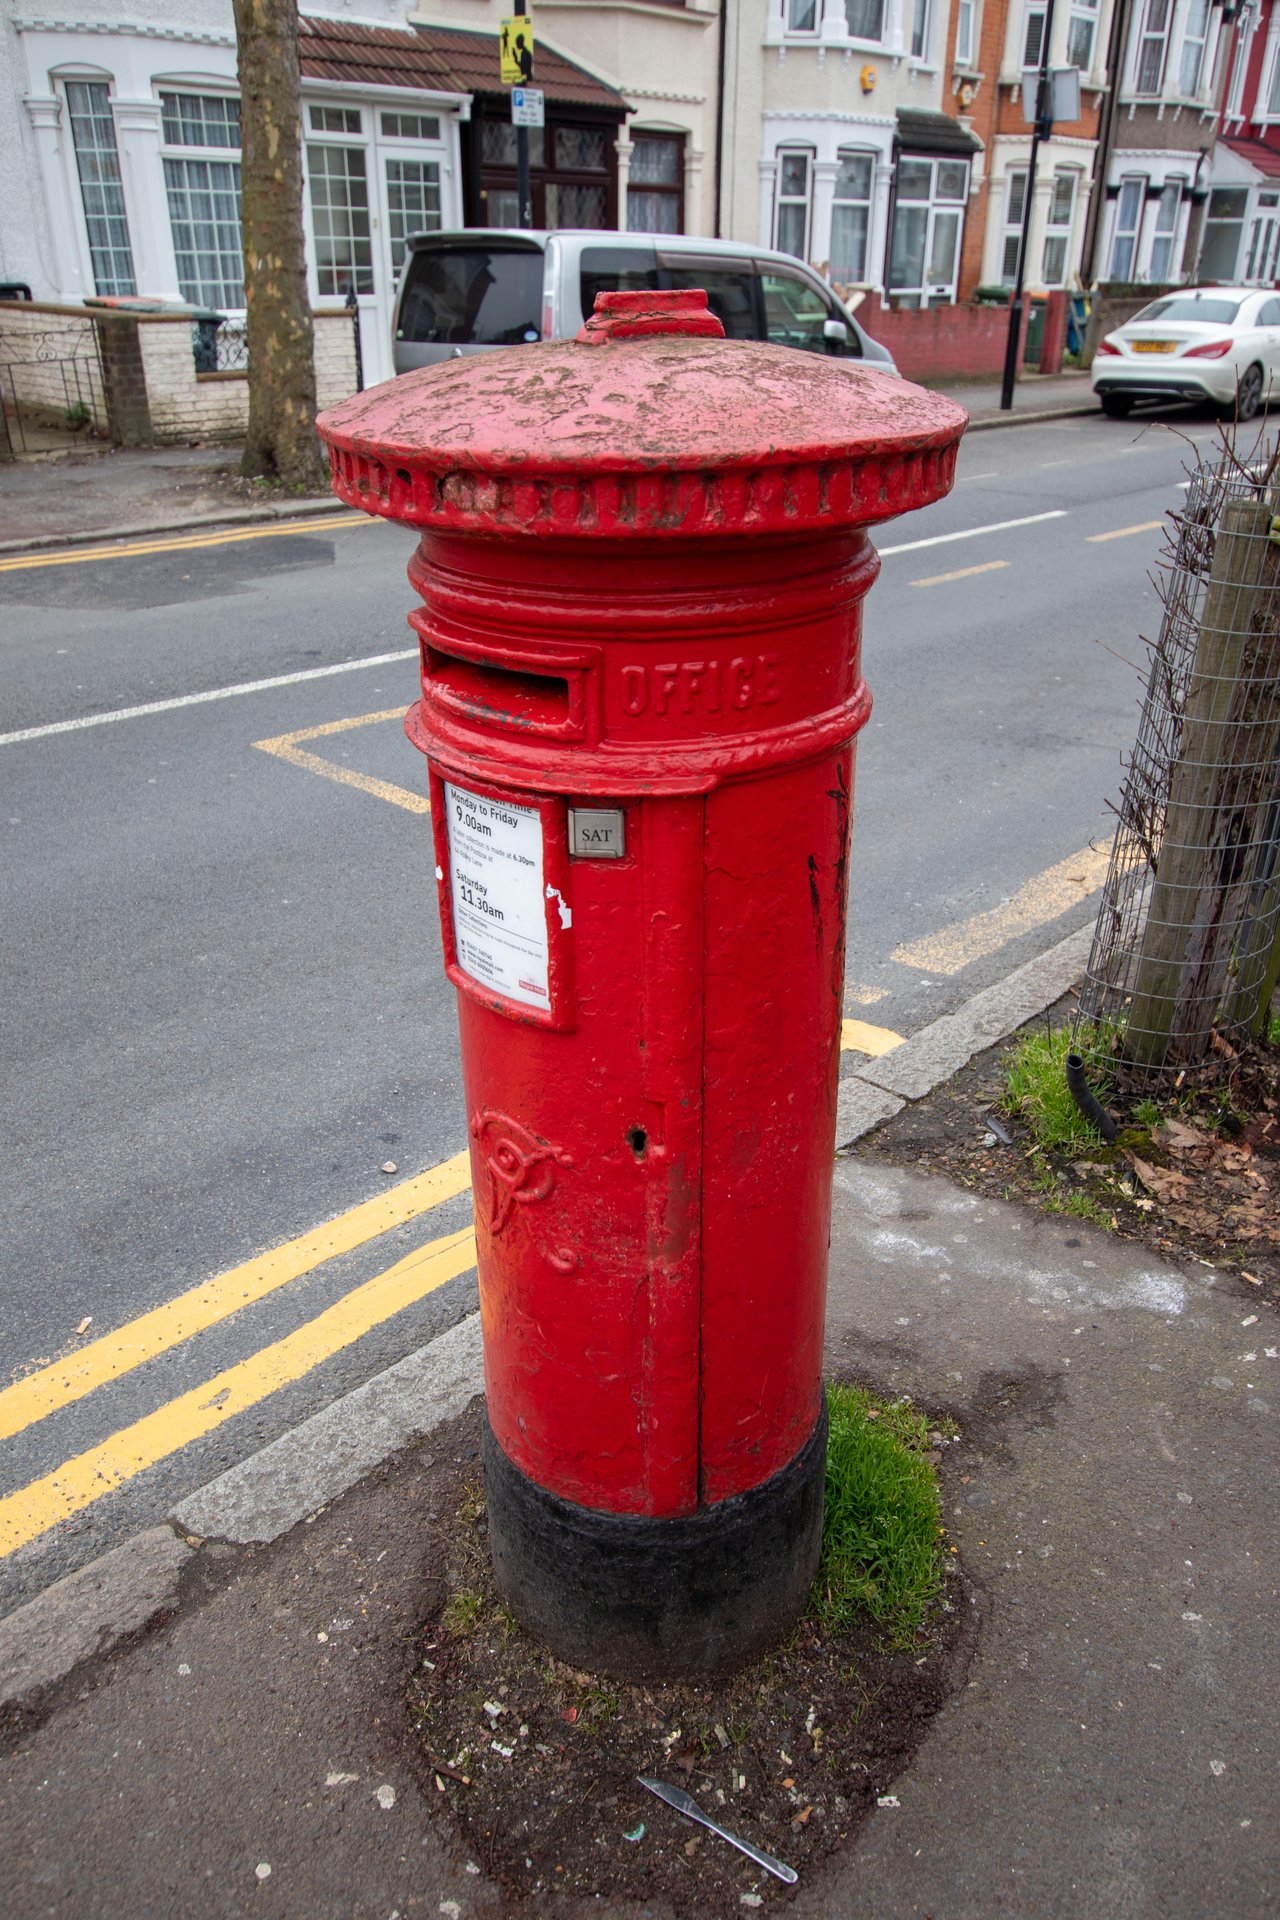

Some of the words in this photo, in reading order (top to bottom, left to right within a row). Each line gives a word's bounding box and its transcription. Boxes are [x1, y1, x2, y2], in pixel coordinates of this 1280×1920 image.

[620, 654, 780, 717] OFFICE
[451, 789, 478, 813] Monday
[479, 804, 488, 816] to
[490, 807, 519, 829] Friday
[456, 805, 492, 837] 9.00am
[582, 828, 612, 842] SAT
[491, 846, 505, 857] made
[513, 854, 536, 867] 6.30pm
[456, 868, 488, 896] Saturday
[460, 885, 504, 921] 11.30am
